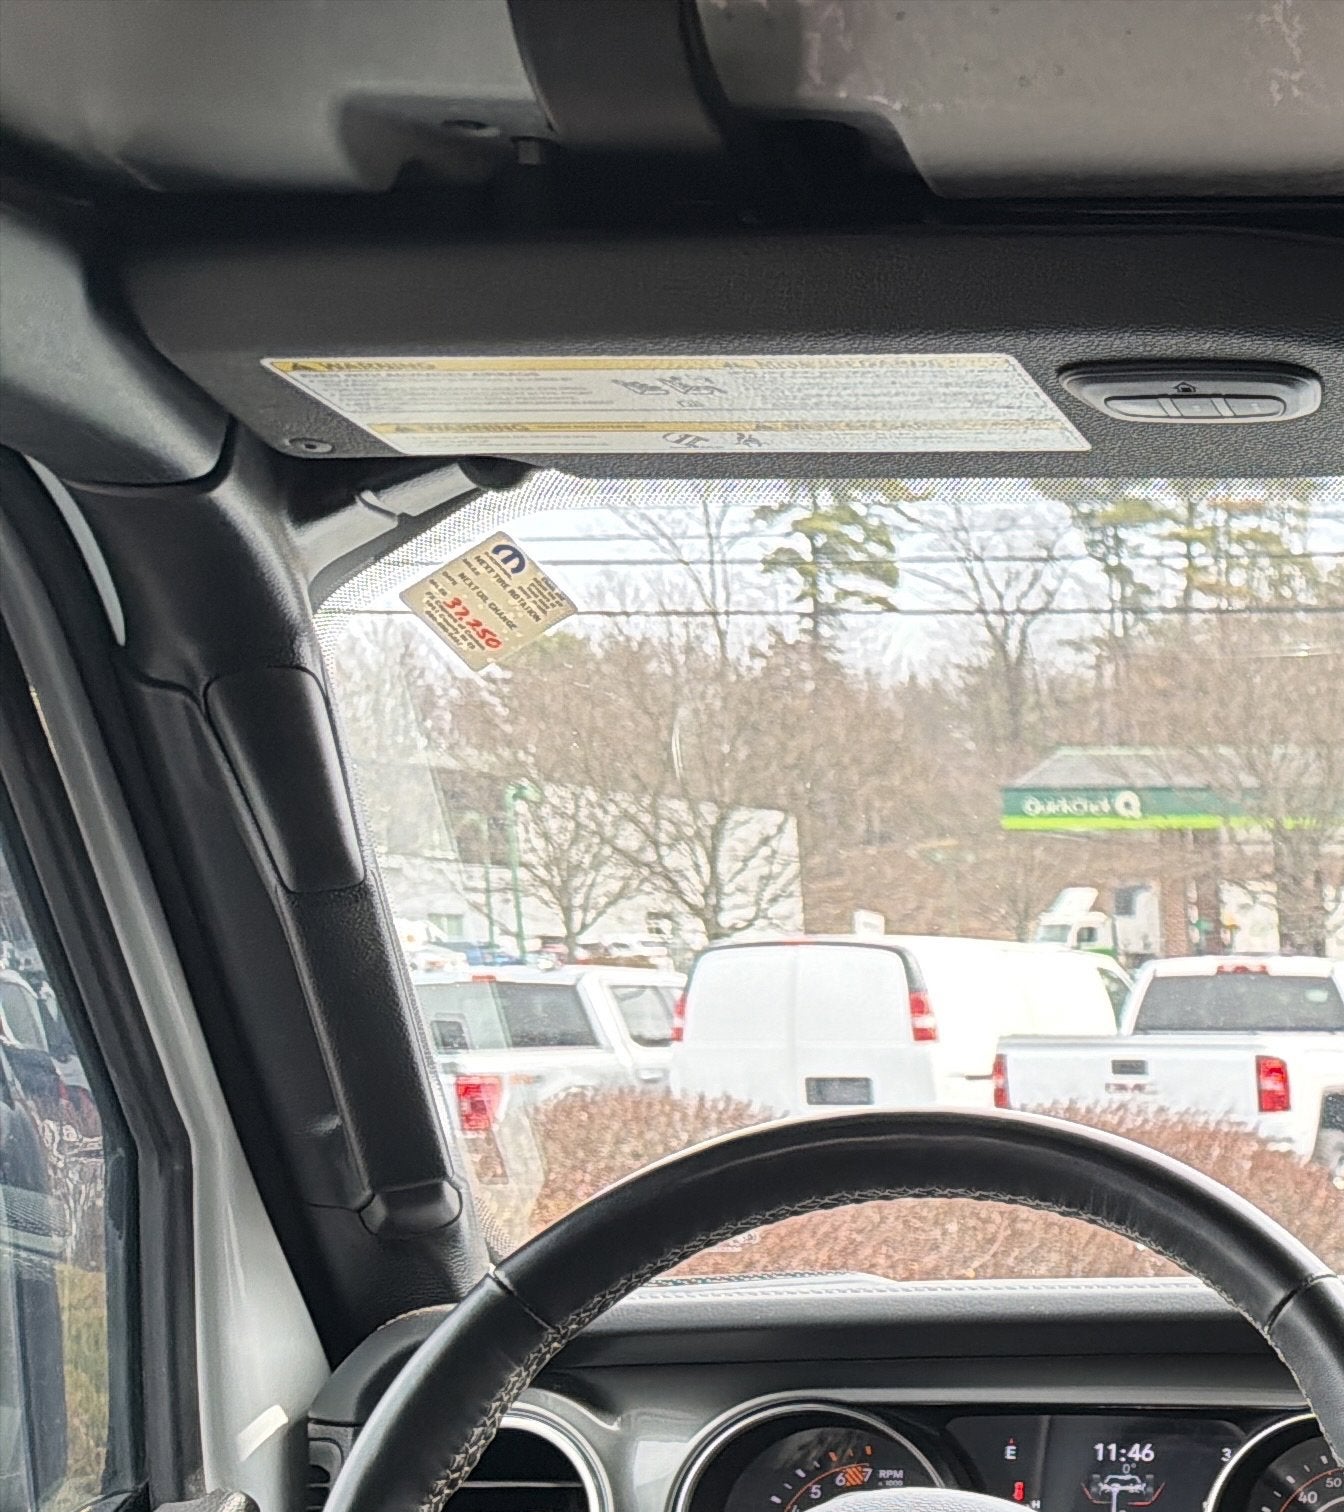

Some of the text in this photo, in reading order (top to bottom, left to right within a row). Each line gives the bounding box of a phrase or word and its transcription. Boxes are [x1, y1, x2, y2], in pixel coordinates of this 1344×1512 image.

[1004, 1445, 1017, 1460] E
[1094, 1443, 1155, 1462] 11:46
[835, 1472, 847, 1486] 6
[863, 1468, 873, 1482] 7
[878, 1469, 904, 1479] RPM
[1325, 1477, 1343, 1488] 50
[809, 1484, 822, 1499] 5
[1297, 1491, 1318, 1504] 40
